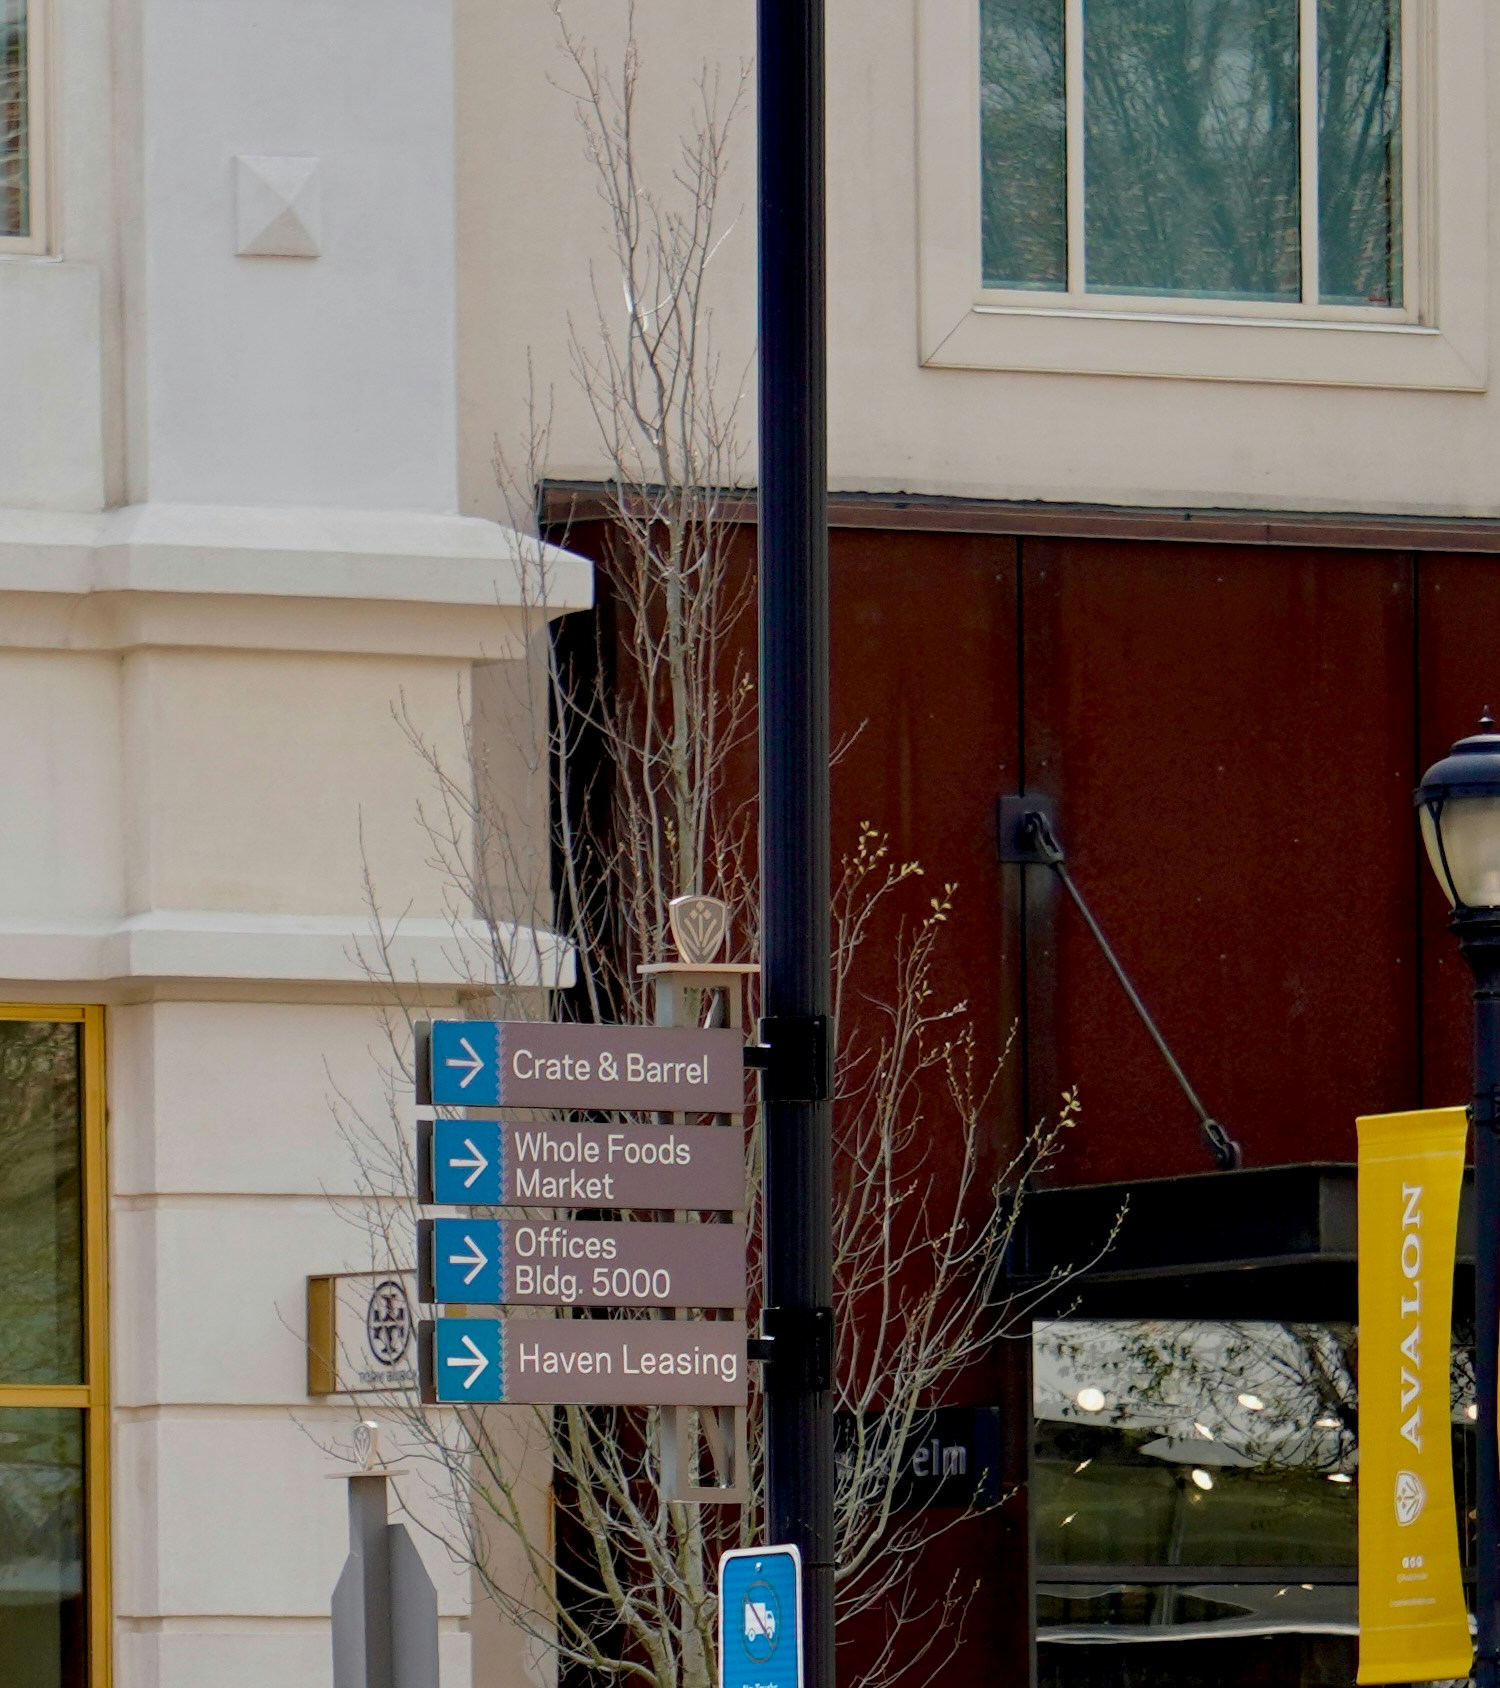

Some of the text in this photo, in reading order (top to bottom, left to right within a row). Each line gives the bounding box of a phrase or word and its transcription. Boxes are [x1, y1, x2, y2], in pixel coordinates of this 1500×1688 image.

[512, 1049, 710, 1085] Crate & Barrel
[514, 1132, 692, 1166] Whole Foods
[515, 1168, 615, 1200] Market
[515, 1227, 617, 1259] Offices
[515, 1265, 671, 1302] Bldg. 5000
[1399, 1181, 1425, 1454] AVALON
[518, 1343, 738, 1383] Haven Leasing
[912, 1438, 968, 1478] elm
